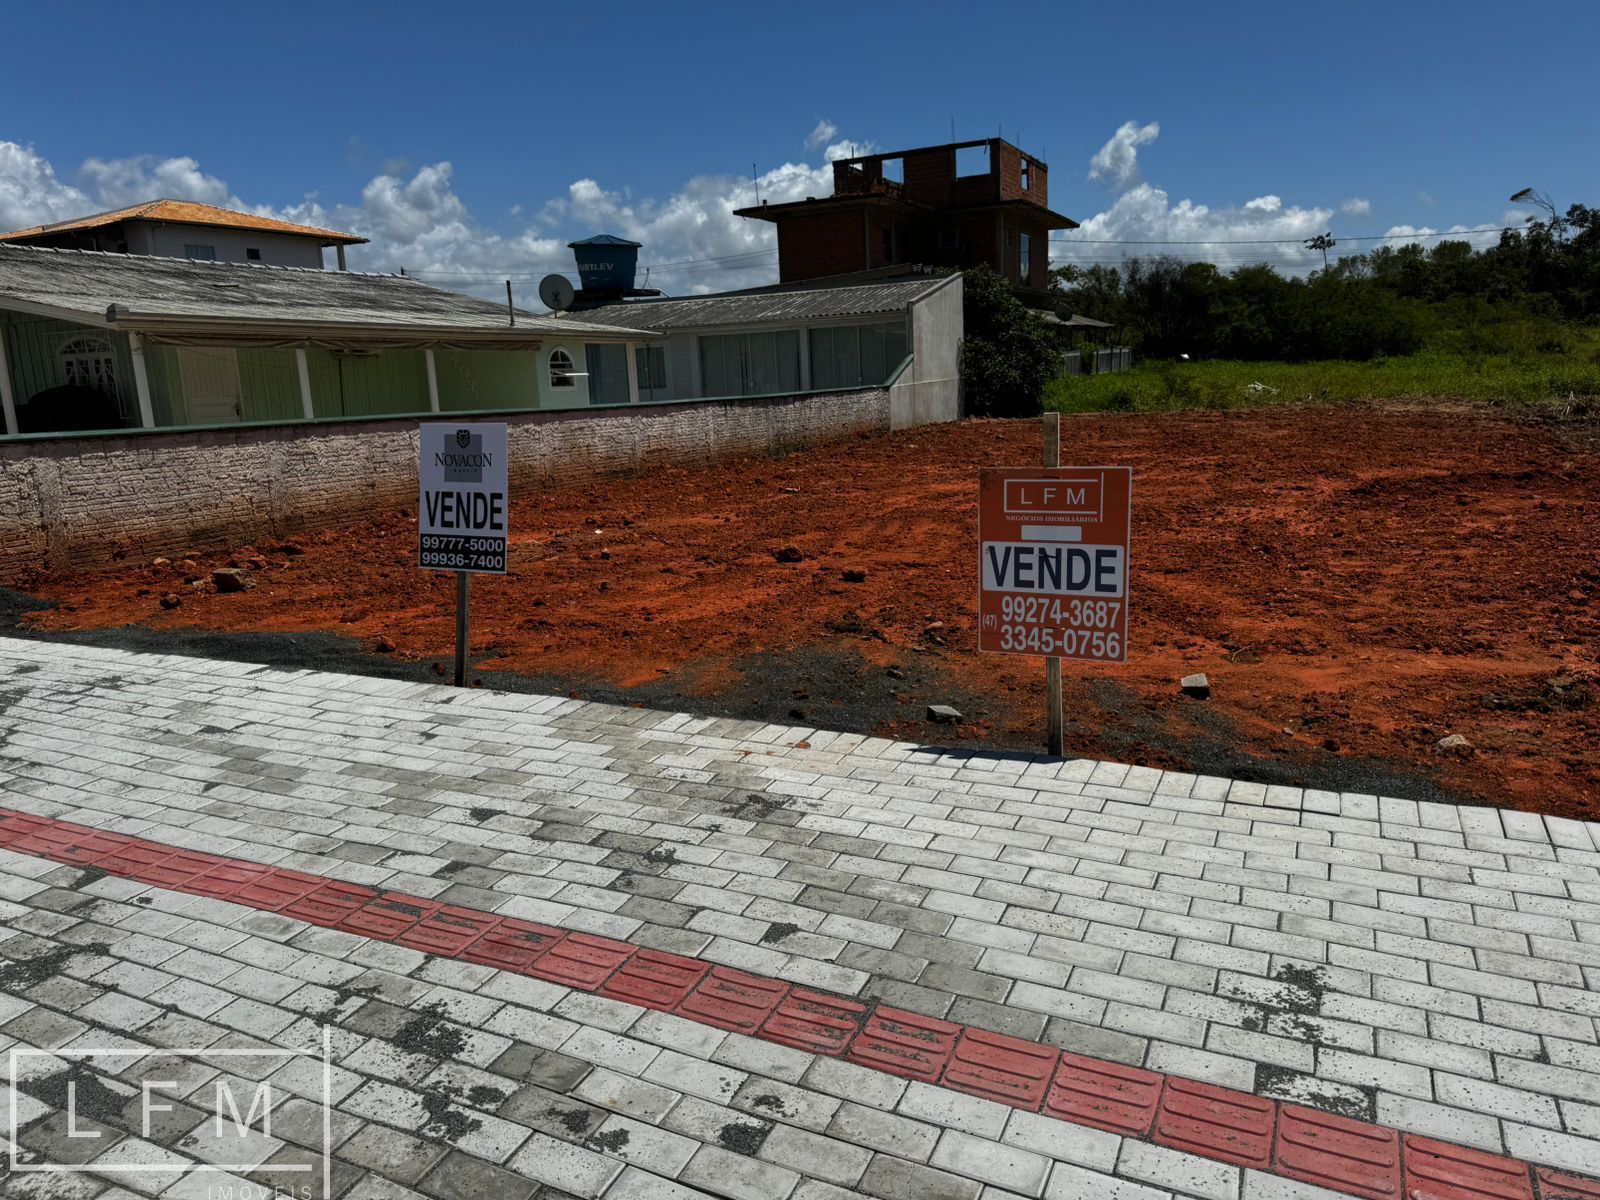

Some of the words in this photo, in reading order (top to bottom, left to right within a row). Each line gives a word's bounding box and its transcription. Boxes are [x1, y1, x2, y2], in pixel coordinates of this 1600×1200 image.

[435, 452, 492, 467] NOVACON
[425, 491, 503, 530] VENDE
[422, 536, 503, 552] 99777-5000
[422, 552, 503, 568] 99936-7400
[988, 546, 1118, 593] VENDE
[1001, 596, 1121, 628] 99274-3687
[1000, 625, 1121, 658] 3345-0756
